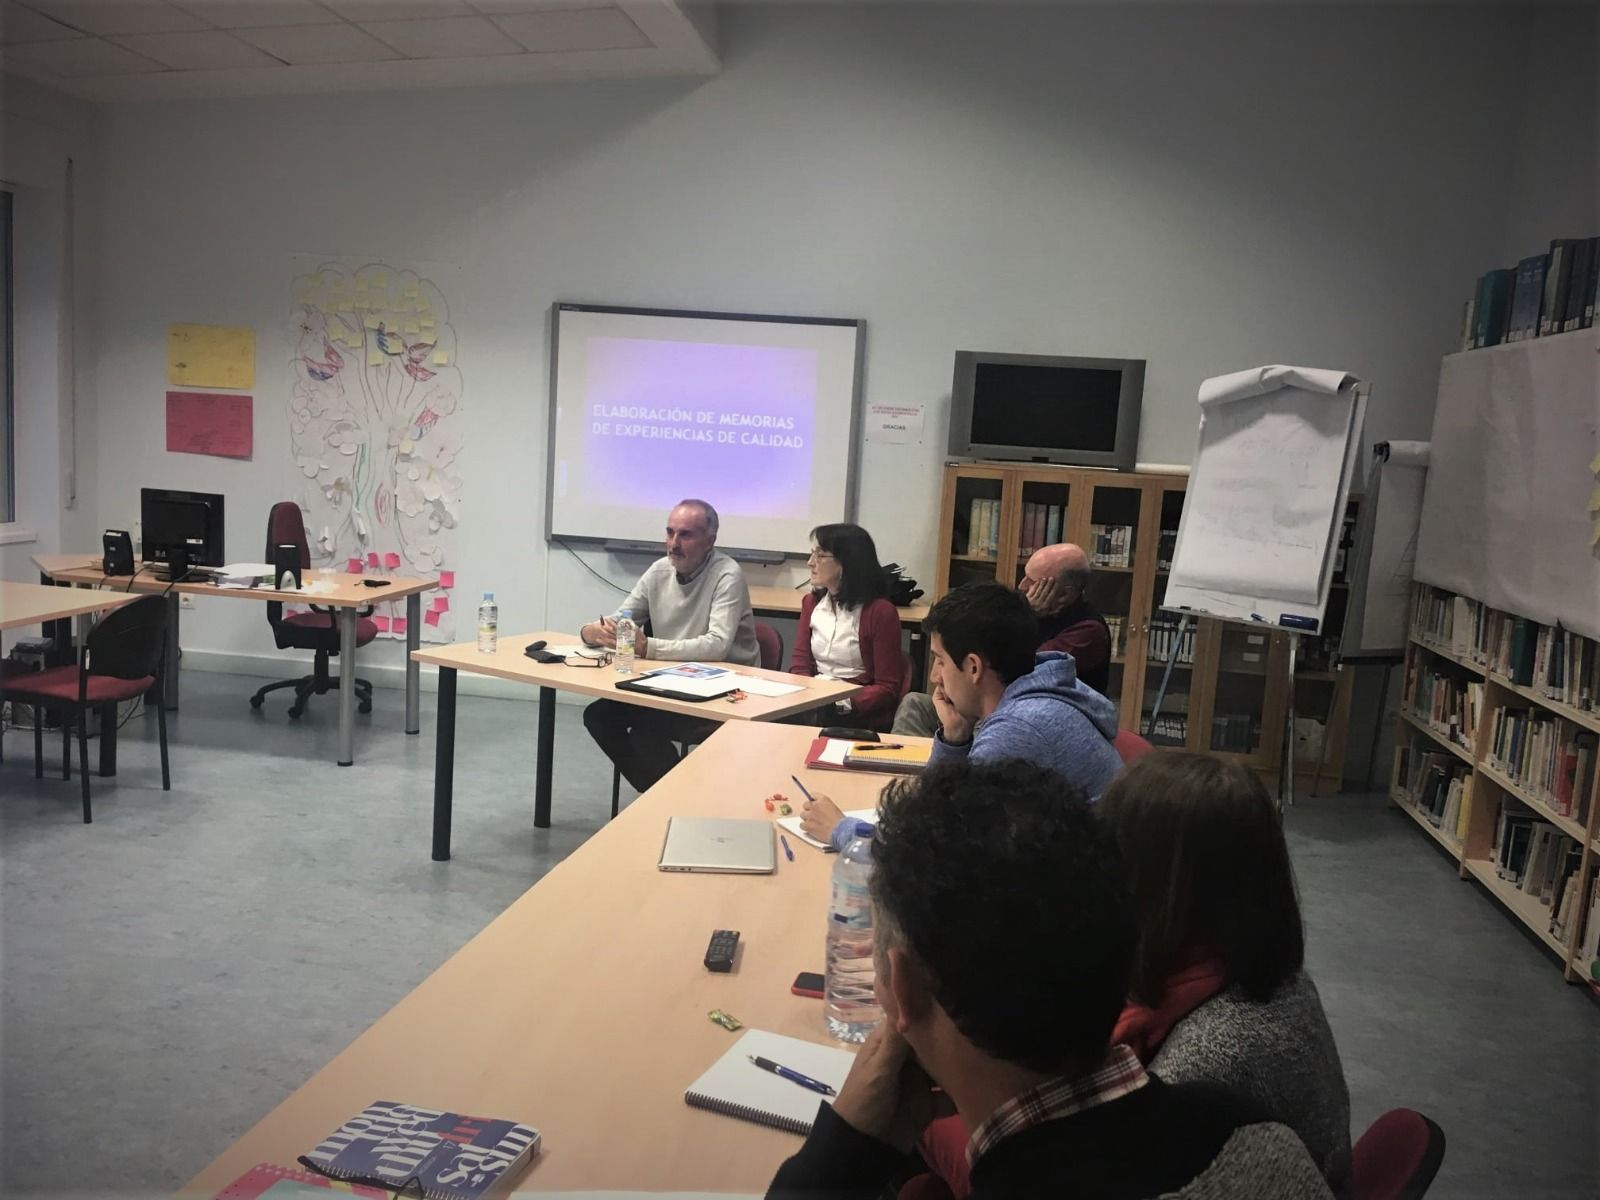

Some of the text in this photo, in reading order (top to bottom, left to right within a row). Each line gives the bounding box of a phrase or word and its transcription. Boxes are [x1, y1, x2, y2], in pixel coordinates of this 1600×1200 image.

[592, 404, 794, 430] ELABORACIÓN DE MEMORIAS
[592, 422, 803, 448] DE EXPERIENCIAS DE CALIDAD
[437, 1143, 490, 1187] sat
